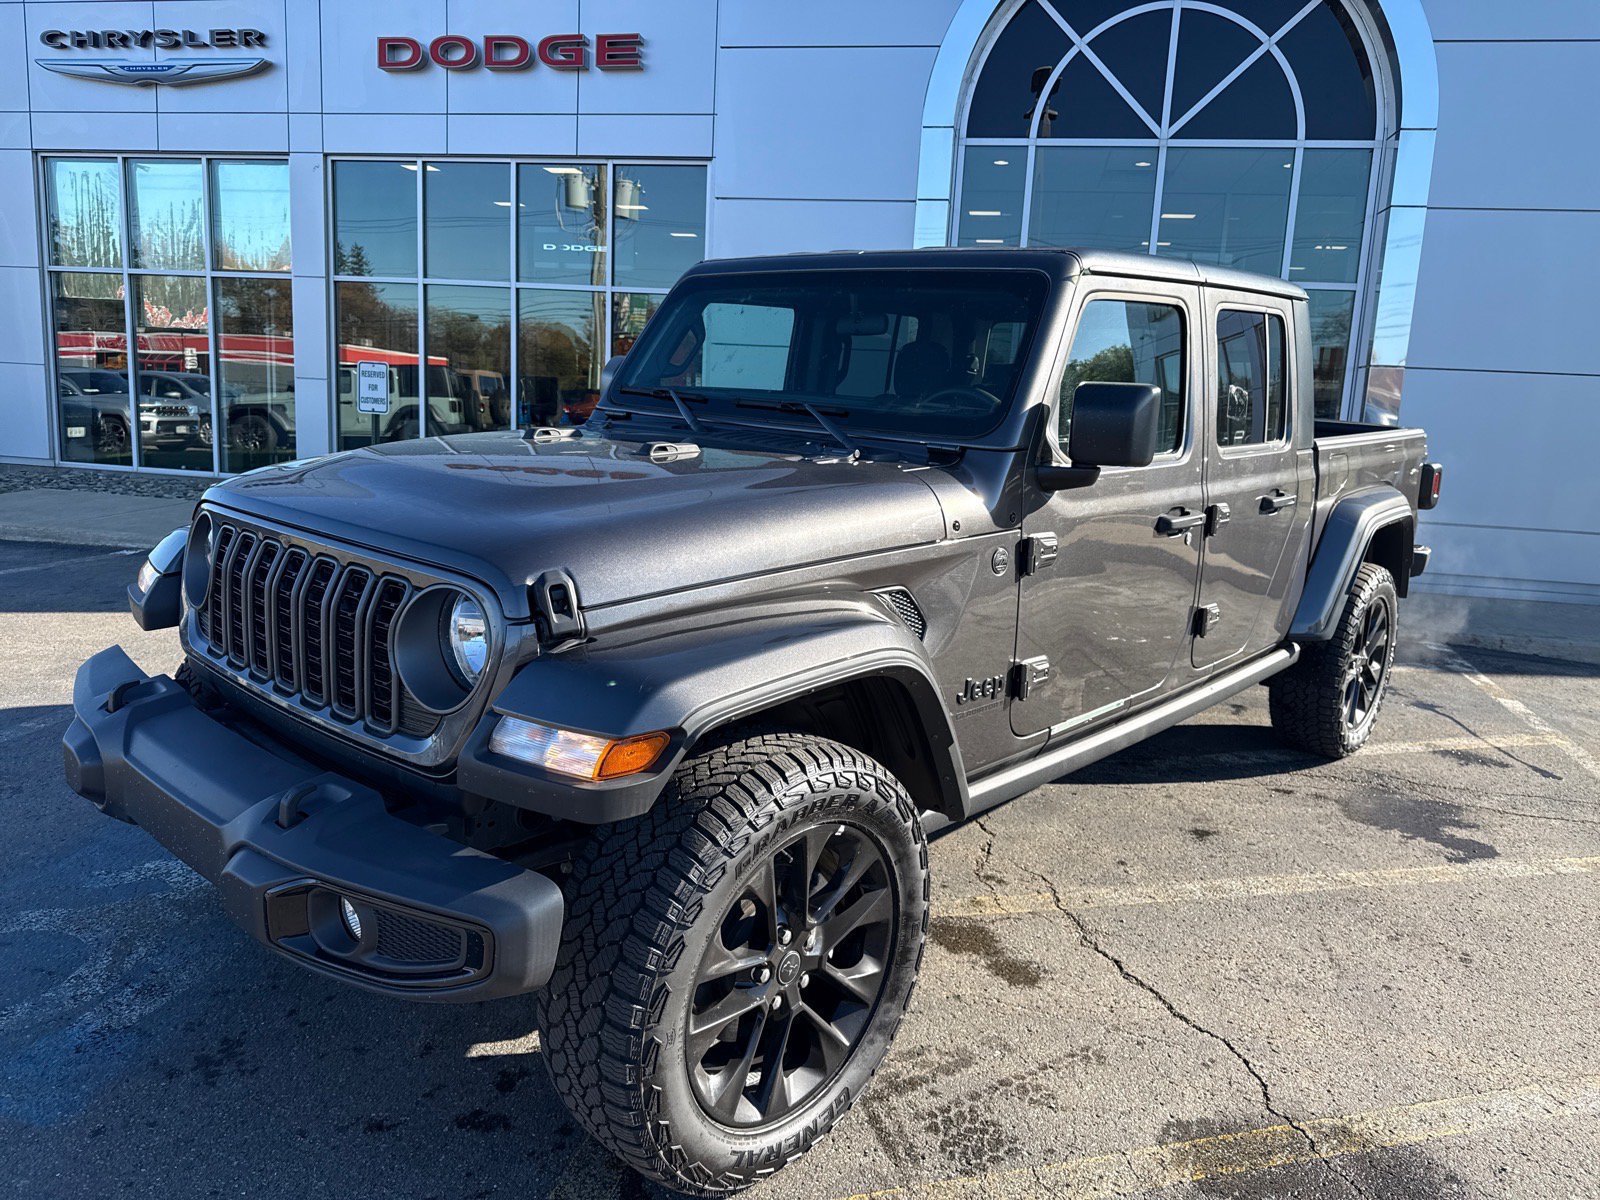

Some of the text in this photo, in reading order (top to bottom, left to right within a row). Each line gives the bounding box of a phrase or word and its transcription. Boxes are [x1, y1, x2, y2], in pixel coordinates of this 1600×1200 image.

[40, 28, 268, 48] CHRYSLER
[377, 33, 644, 71] DODGE
[361, 370, 386, 379] RESERVED
[368, 383, 379, 391] FOR
[361, 396, 386, 405] CUSTOMERS
[956, 674, 1004, 705] Jeep
[735, 793, 860, 881] GRABBER
[729, 1086, 851, 1169] GENERAL
